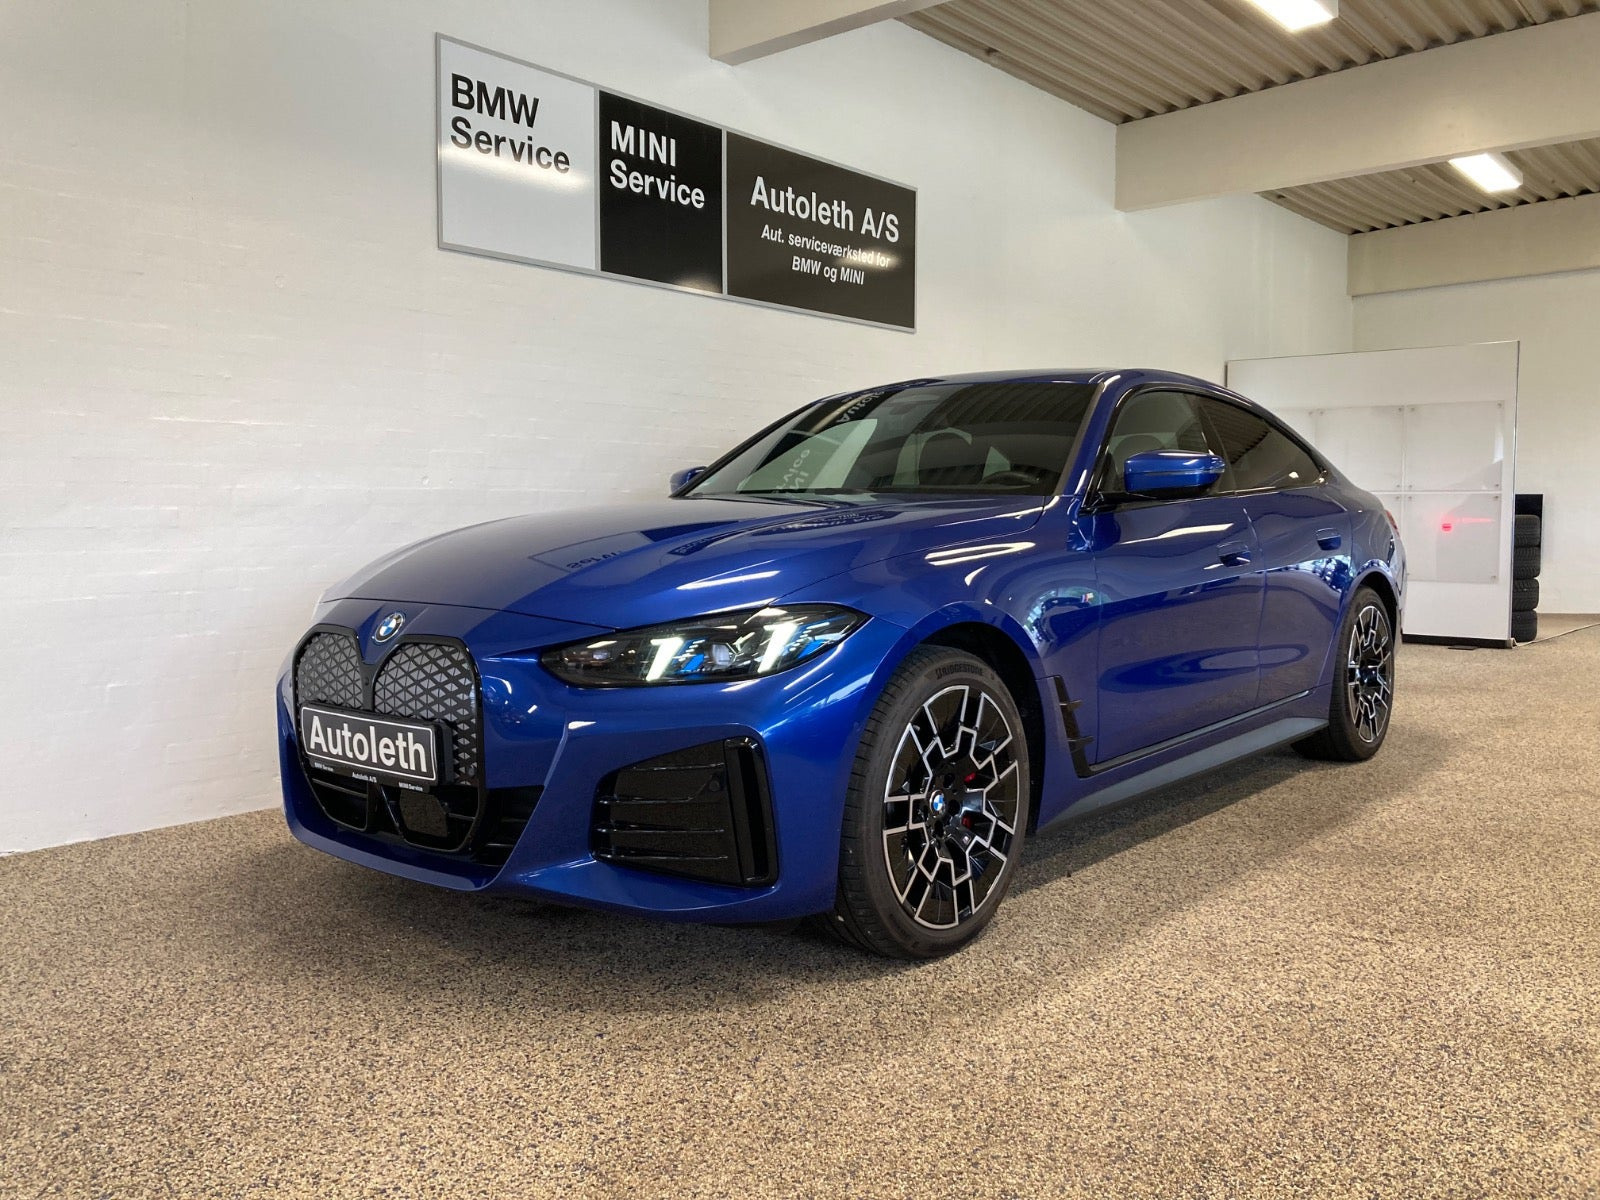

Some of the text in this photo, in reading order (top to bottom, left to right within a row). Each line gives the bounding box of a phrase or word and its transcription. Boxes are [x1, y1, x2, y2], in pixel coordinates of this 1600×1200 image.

[451, 73, 539, 128] BMW
[450, 116, 570, 173] Service
[611, 120, 676, 167] MINI
[610, 159, 705, 208] Service
[750, 176, 899, 243] Autoleth A/S
[761, 224, 891, 268] Aut. serviceværksted for
[792, 256, 865, 285] BMW og MINI
[310, 715, 427, 772] Autoleth
